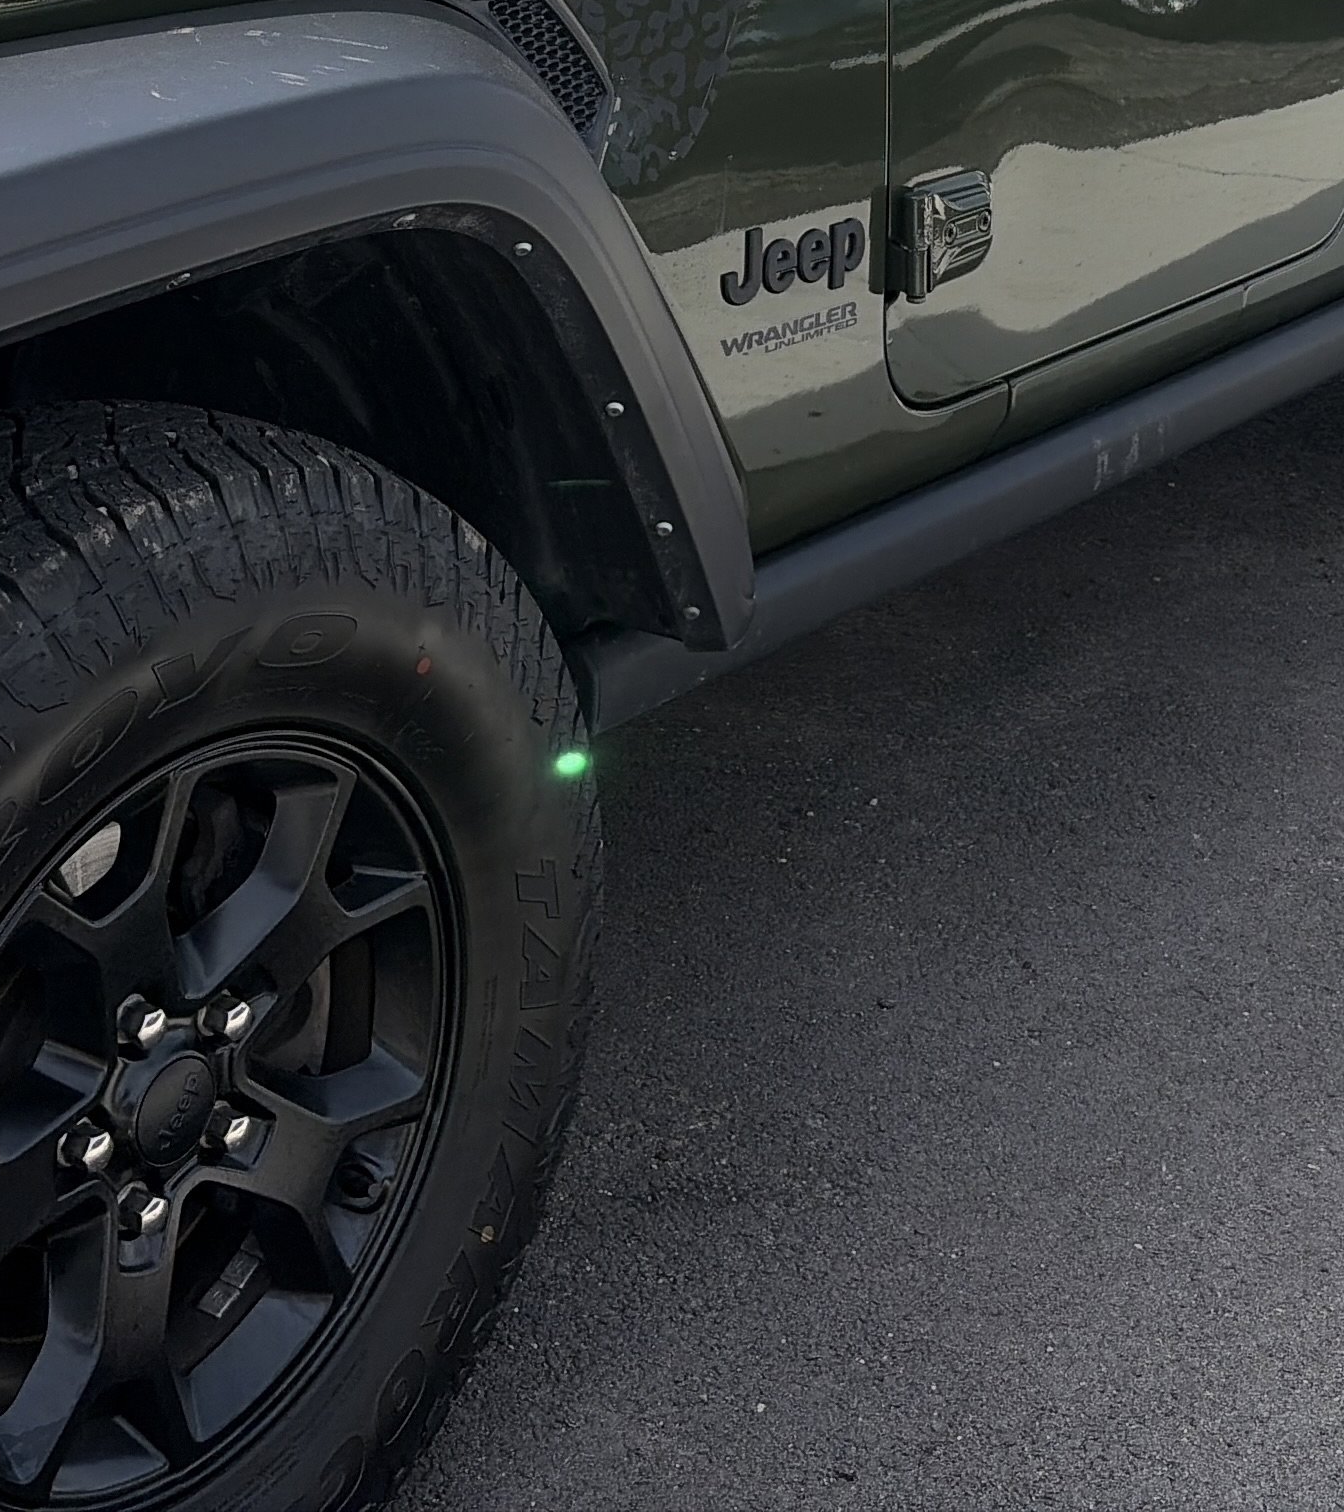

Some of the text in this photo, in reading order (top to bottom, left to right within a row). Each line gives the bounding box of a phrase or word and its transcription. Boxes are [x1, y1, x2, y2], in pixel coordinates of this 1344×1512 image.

[720, 217, 866, 306] Jeep
[720, 301, 858, 356] WRANGLER
[764, 317, 858, 353] UNLIMITED
[159, 1072, 199, 1150] Jeep
[284, 859, 560, 1512] TAMAROC
